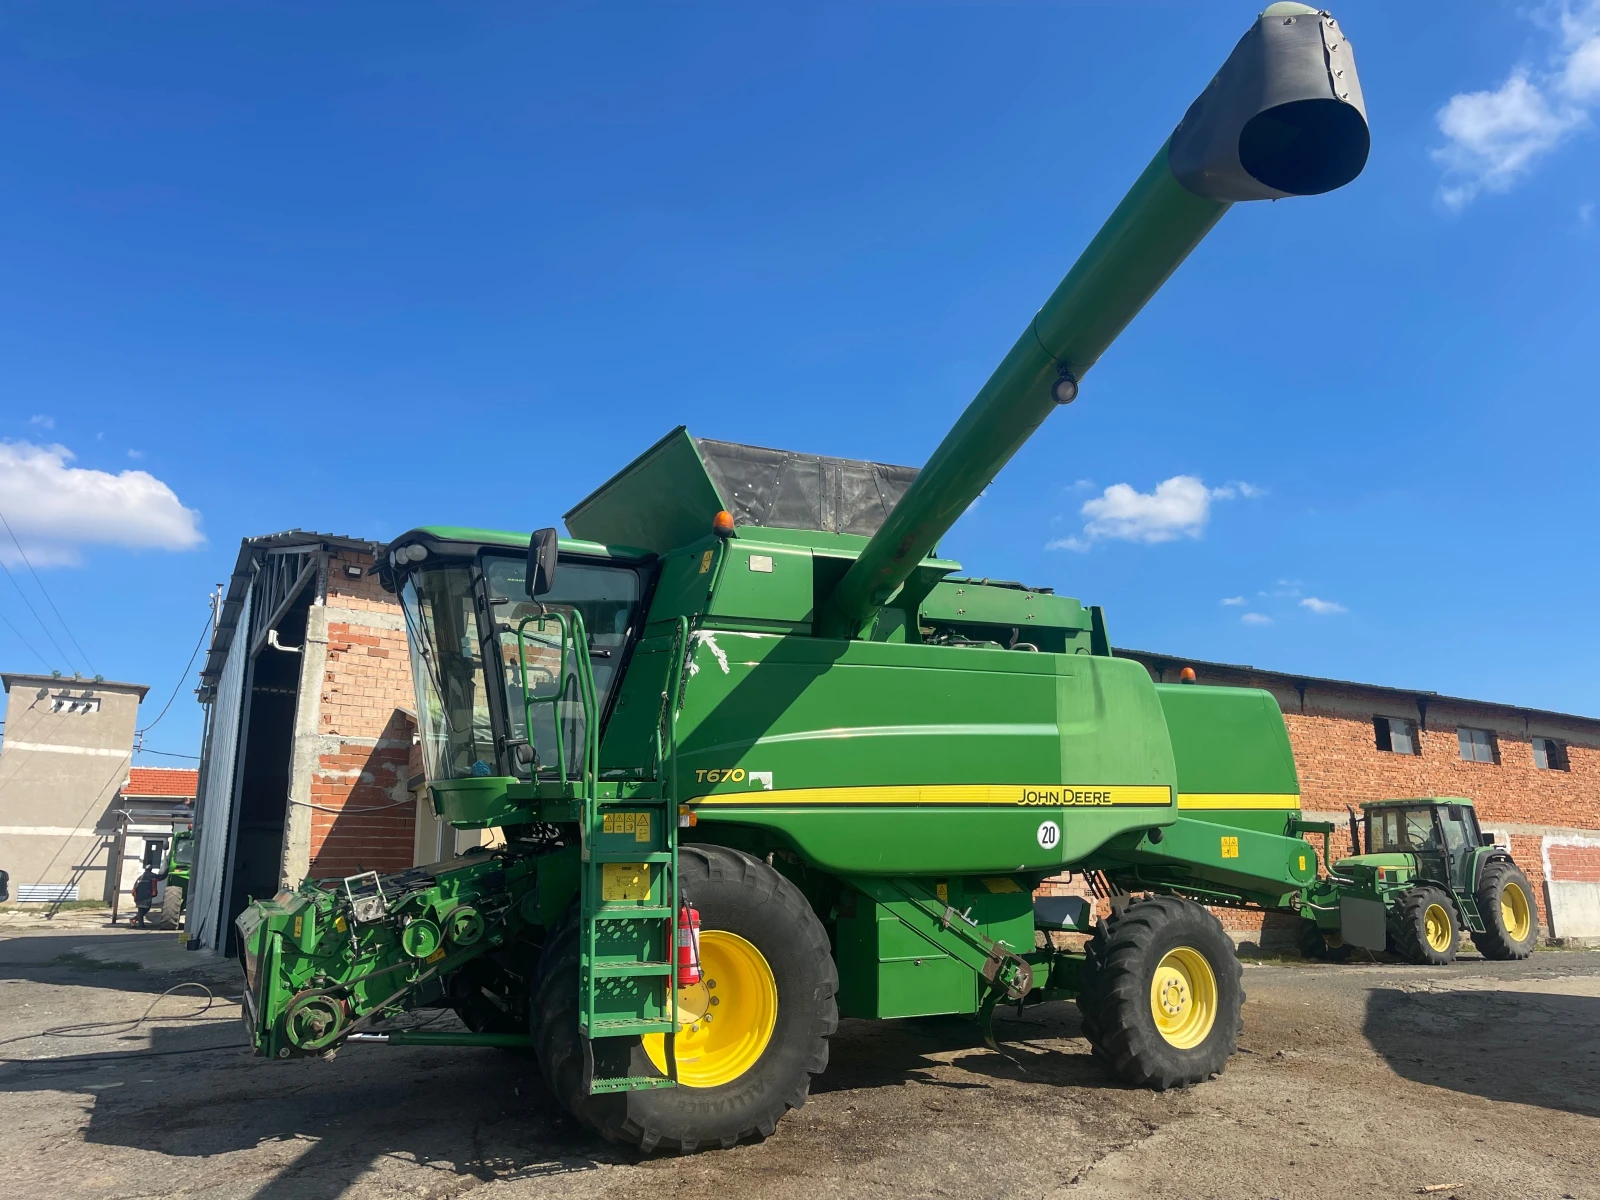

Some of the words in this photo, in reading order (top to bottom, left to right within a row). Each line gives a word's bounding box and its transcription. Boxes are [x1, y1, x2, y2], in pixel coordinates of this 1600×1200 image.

[695, 767, 746, 783] T670
[1017, 788, 1059, 804] JOHN
[1062, 788, 1111, 804] DEERE
[1041, 825, 1056, 844] 20
